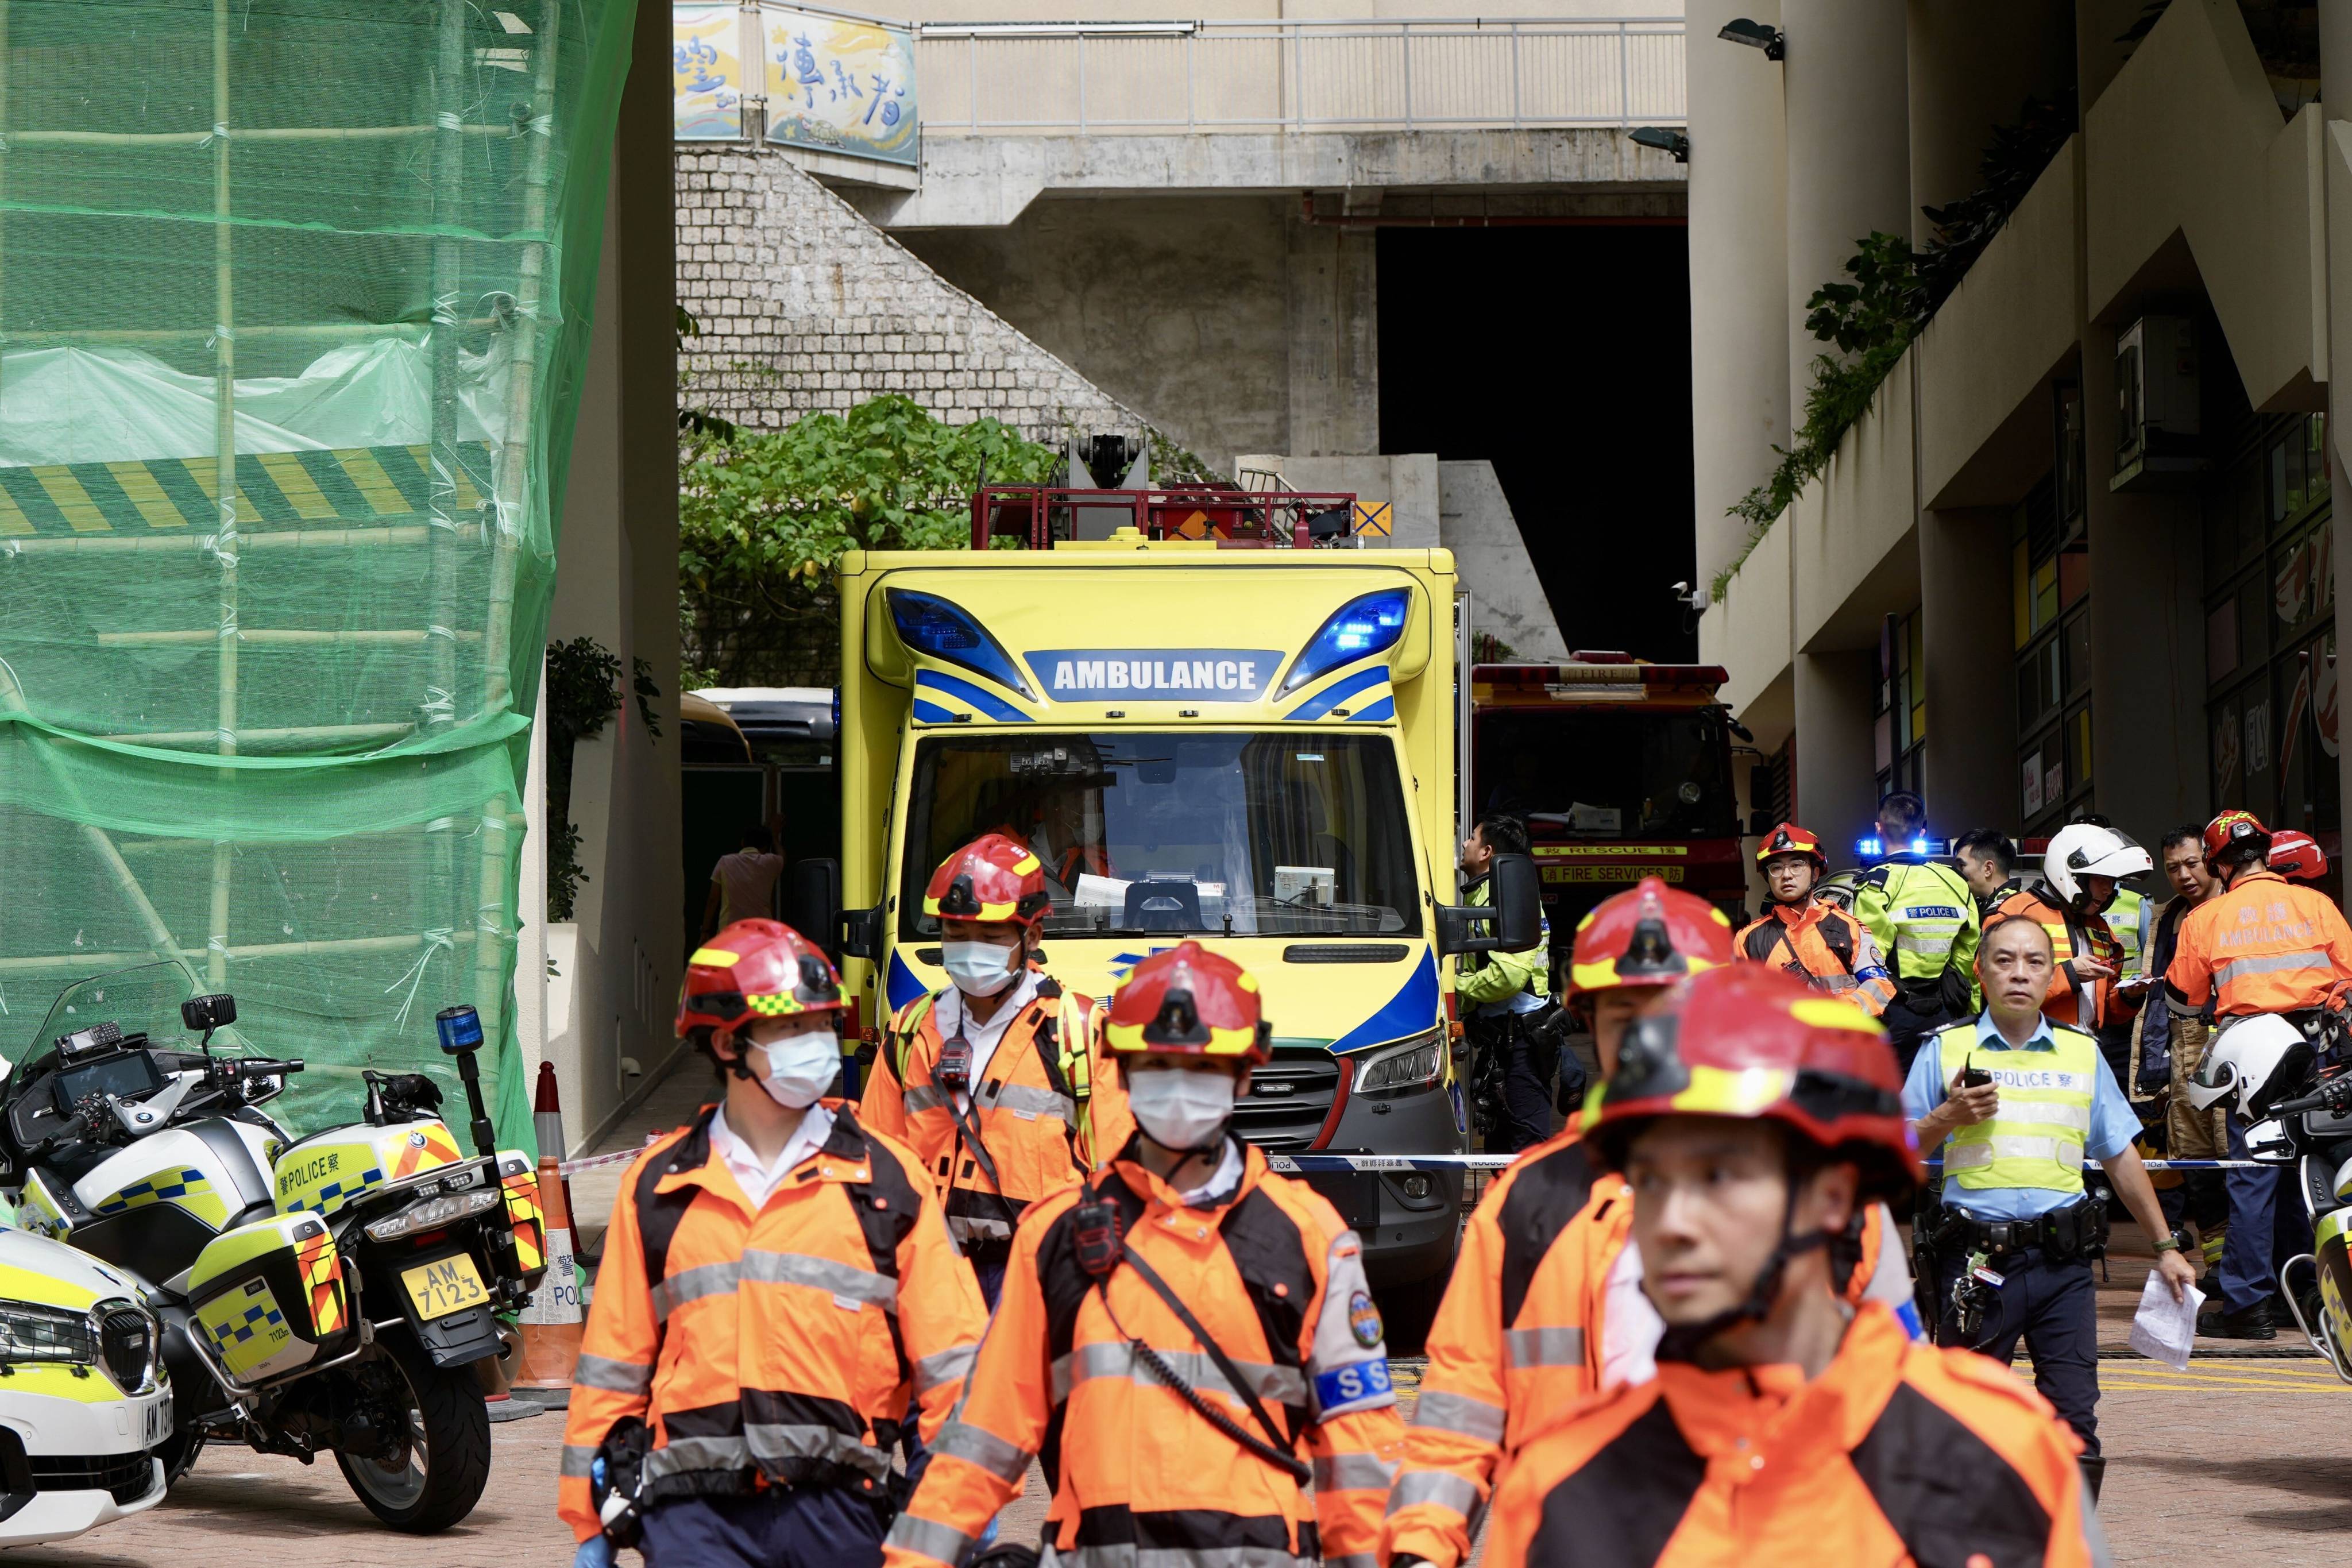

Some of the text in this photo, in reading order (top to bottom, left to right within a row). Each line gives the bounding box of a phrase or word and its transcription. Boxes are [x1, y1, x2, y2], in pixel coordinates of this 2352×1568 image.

[1053, 661, 1257, 690] AMBULANCE
[1581, 669, 1619, 679] FIRE
[1545, 867, 1681, 881] 消 FIRE SERVICES 防
[1920, 907, 1950, 917] POLICE
[2219, 920, 2315, 948] AMBULANCE
[1994, 1071, 2072, 1087] POLICE 察
[288, 1156, 327, 1192] POLICE
[327, 1153, 340, 1173] 察
[1268, 1161, 1291, 1169] POLIC
[426, 1261, 459, 1289] AM
[556, 1254, 574, 1277] 警
[418, 1277, 480, 1313] 7123
[268, 1327, 284, 1343] 7123
[146, 1403, 157, 1442] AM
